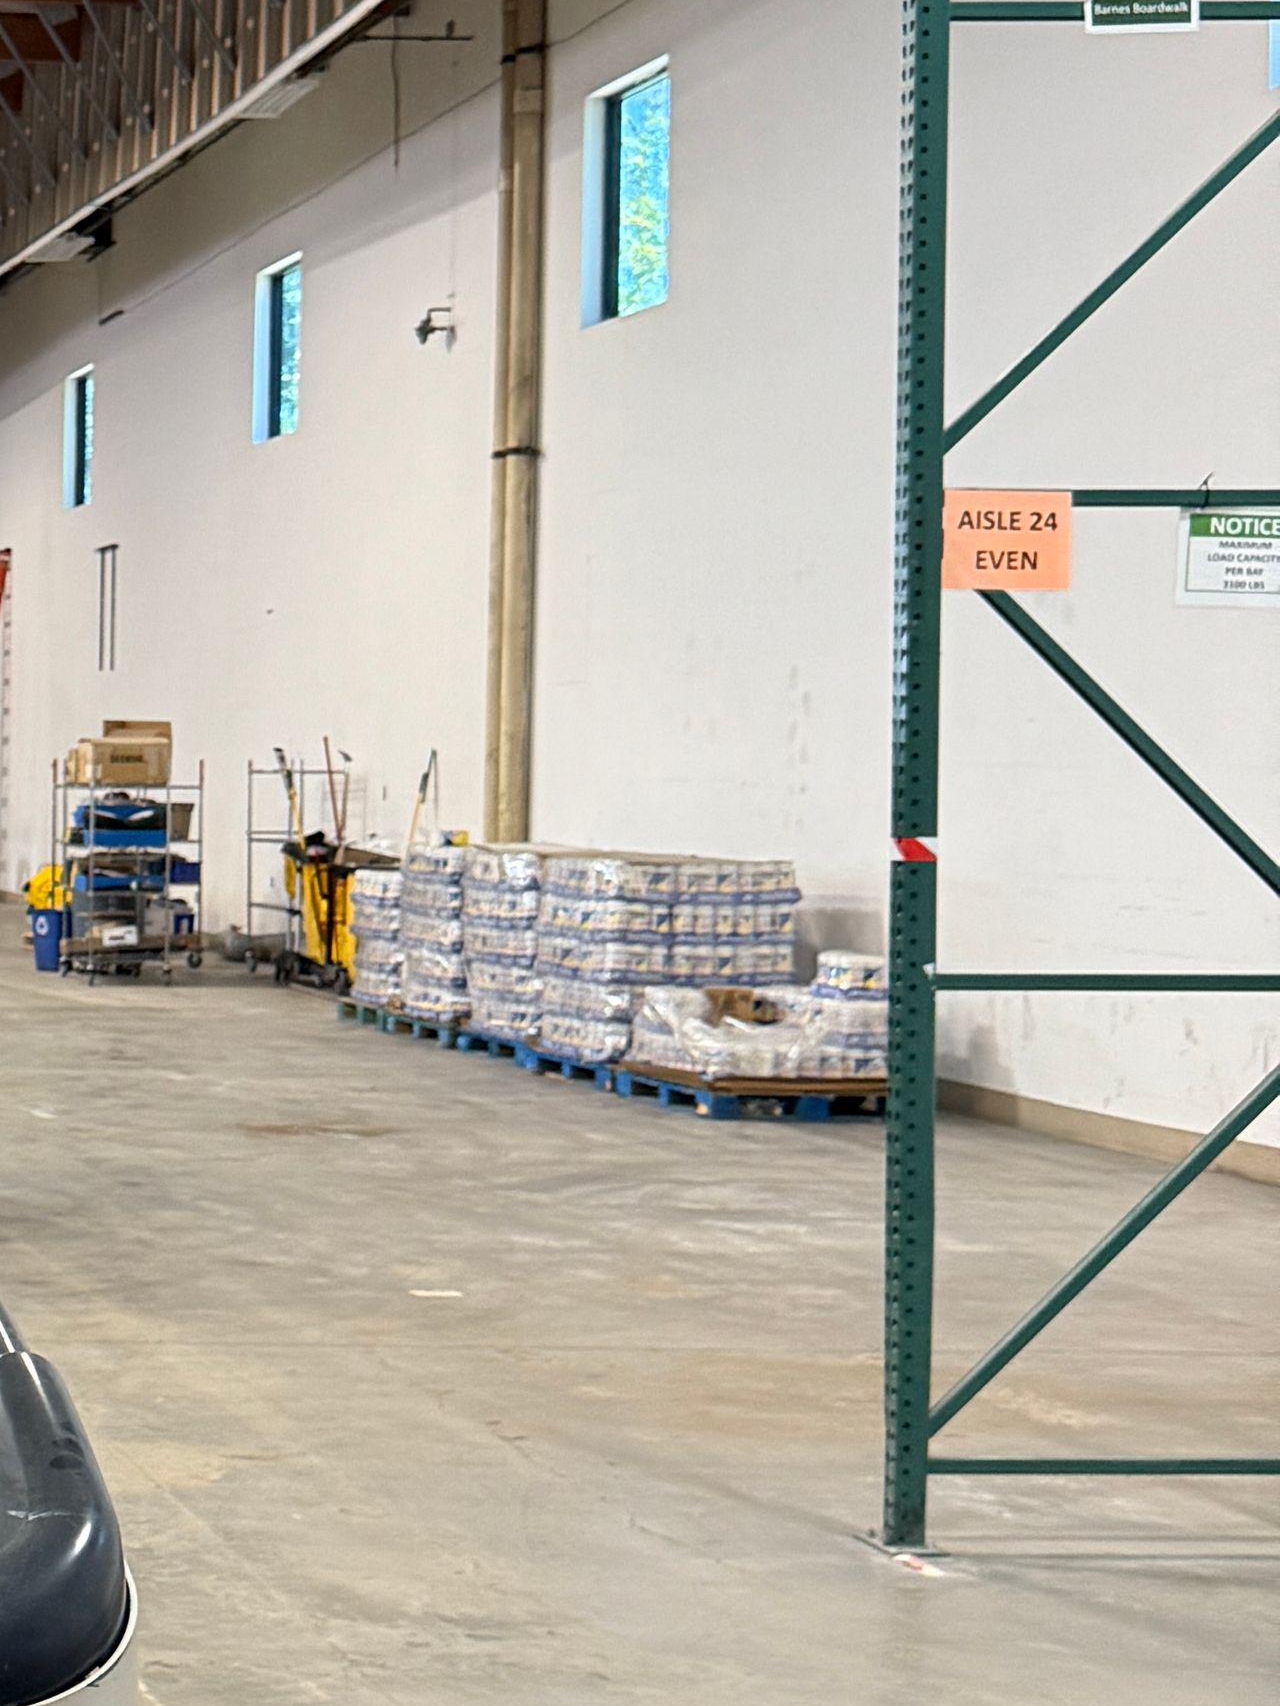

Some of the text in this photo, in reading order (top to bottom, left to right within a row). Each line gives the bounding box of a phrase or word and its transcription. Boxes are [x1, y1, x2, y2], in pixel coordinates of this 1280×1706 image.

[958, 510, 1058, 531] AISLE 24
[1209, 516, 1280, 535] NOTICE
[1219, 541, 1273, 549] MAXIMUM
[975, 550, 1038, 570] EVEN
[1207, 552, 1235, 562] LOAD
[1225, 567, 1264, 576] PER BAY
